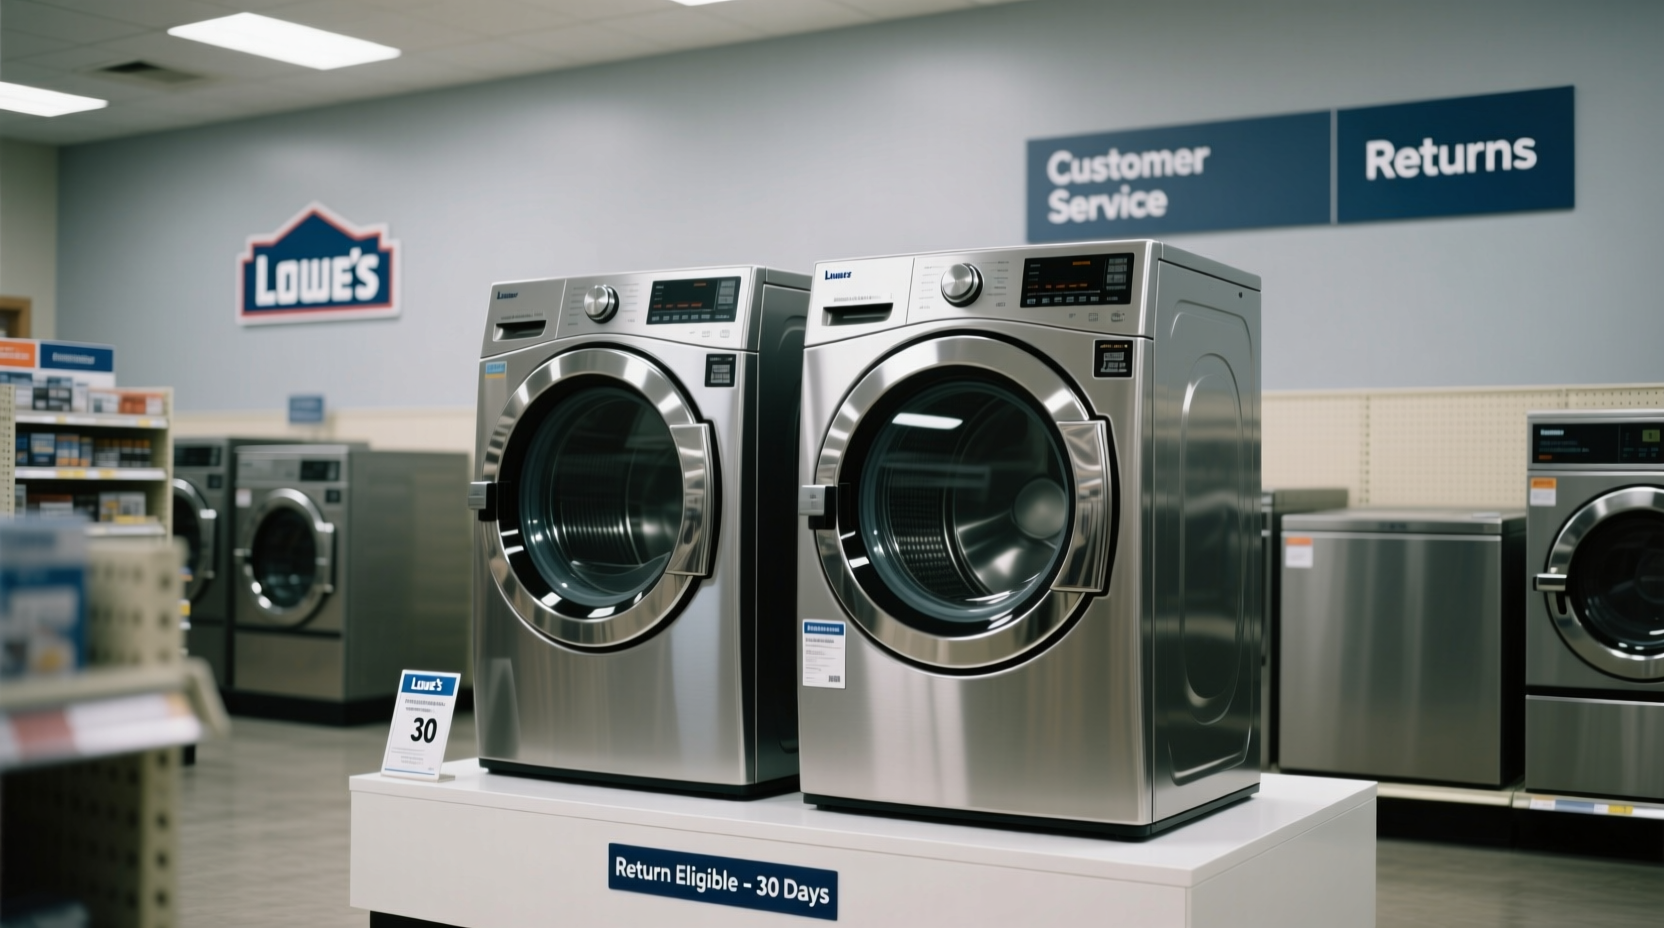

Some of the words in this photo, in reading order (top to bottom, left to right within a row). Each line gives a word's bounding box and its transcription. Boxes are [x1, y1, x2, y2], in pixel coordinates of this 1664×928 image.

[1047, 146, 1211, 186] Customer
[1365, 137, 1538, 181] Returns
[1048, 184, 1168, 224] Service
[255, 246, 380, 307] LOWE'S
[410, 717, 437, 743] 30
[615, 856, 671, 883] Return
[675, 864, 739, 893] Eligible
[756, 875, 780, 898] 30
[783, 878, 830, 907] Days
